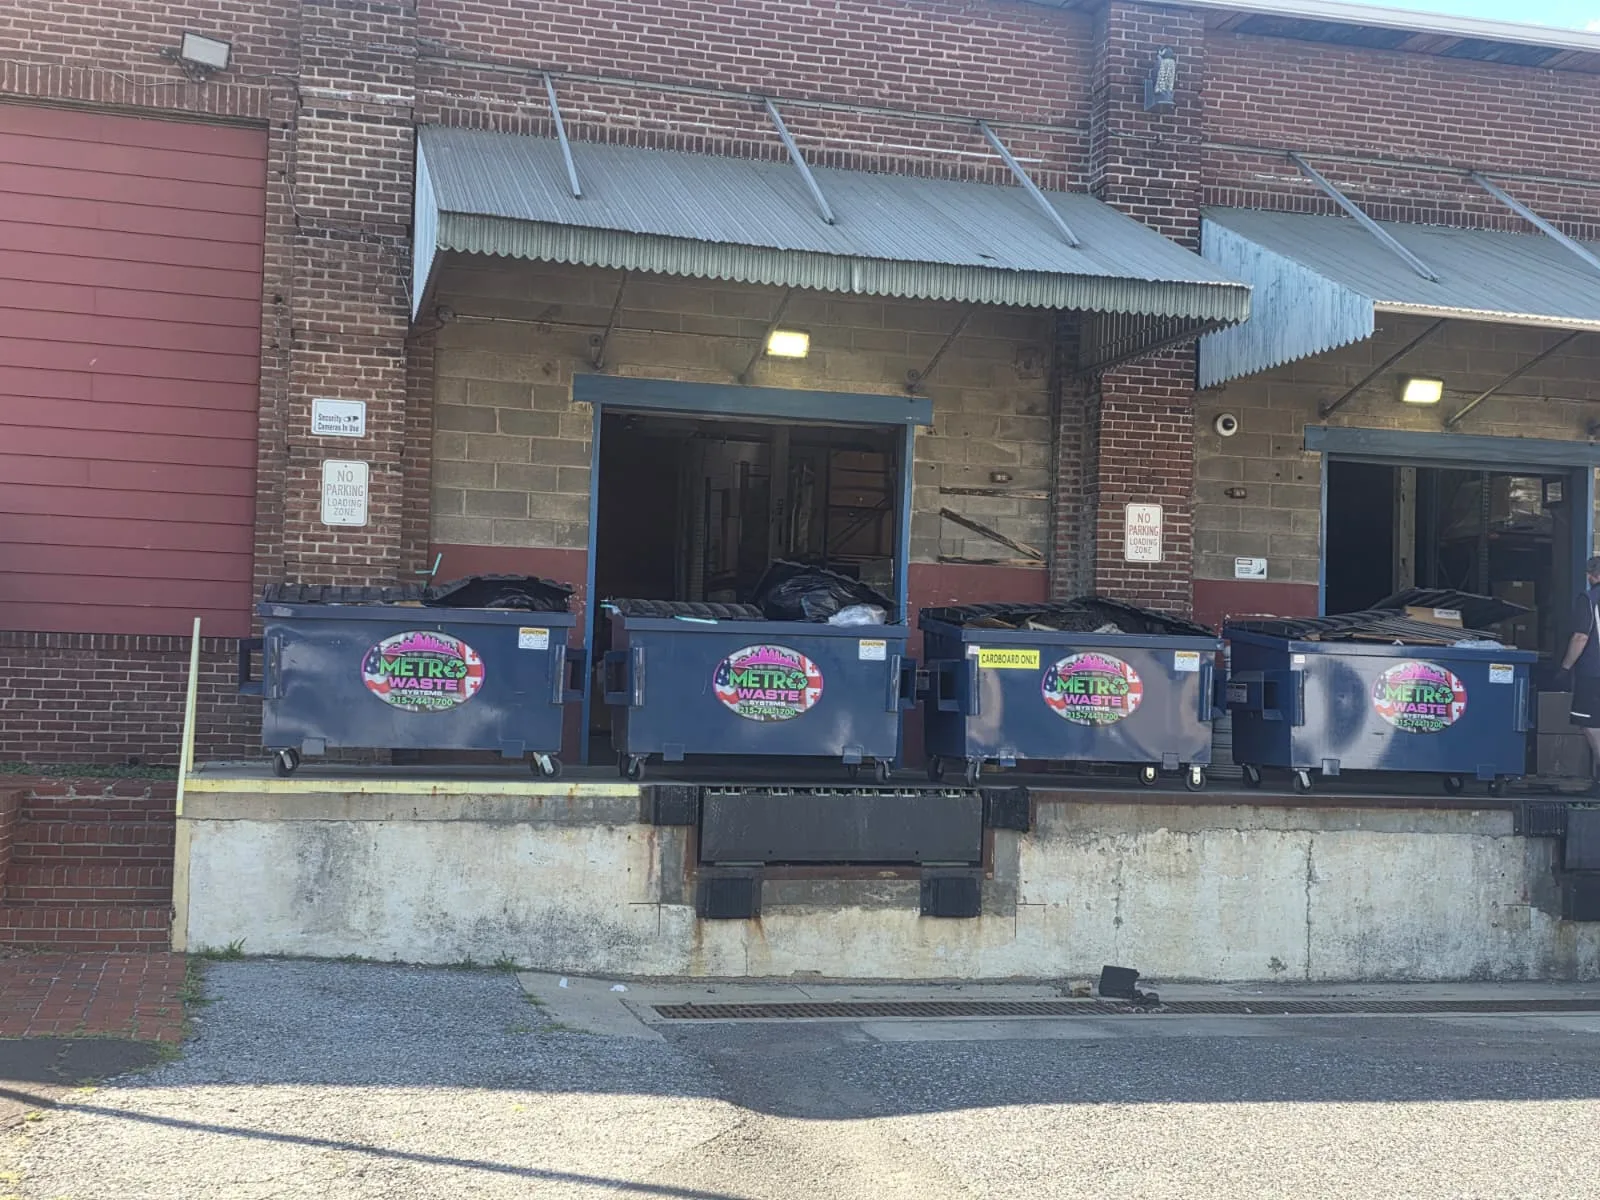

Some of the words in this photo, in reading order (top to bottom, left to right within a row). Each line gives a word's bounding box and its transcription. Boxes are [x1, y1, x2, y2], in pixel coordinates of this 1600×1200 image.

[318, 413, 342, 424] Security
[318, 422, 341, 431] Cameras
[349, 424, 359, 432] Use
[337, 470, 354, 483] NO
[326, 484, 364, 497] PARKING
[327, 497, 362, 508] LOADING
[333, 507, 356, 517] ZONE
[1137, 513, 1151, 523] NO
[1128, 525, 1159, 537] PARKING
[1129, 537, 1158, 546] LOADING
[1134, 546, 1153, 554] ZONE
[981, 654, 1020, 664] CARDBOARD
[1020, 655, 1038, 665] ONLY
[388, 676, 458, 691] WASTE
[736, 688, 800, 701] WASTE
[1064, 693, 1122, 706] WASTE
[748, 699, 786, 707] SYSTEMS
[1392, 702, 1447, 715] WASTE
